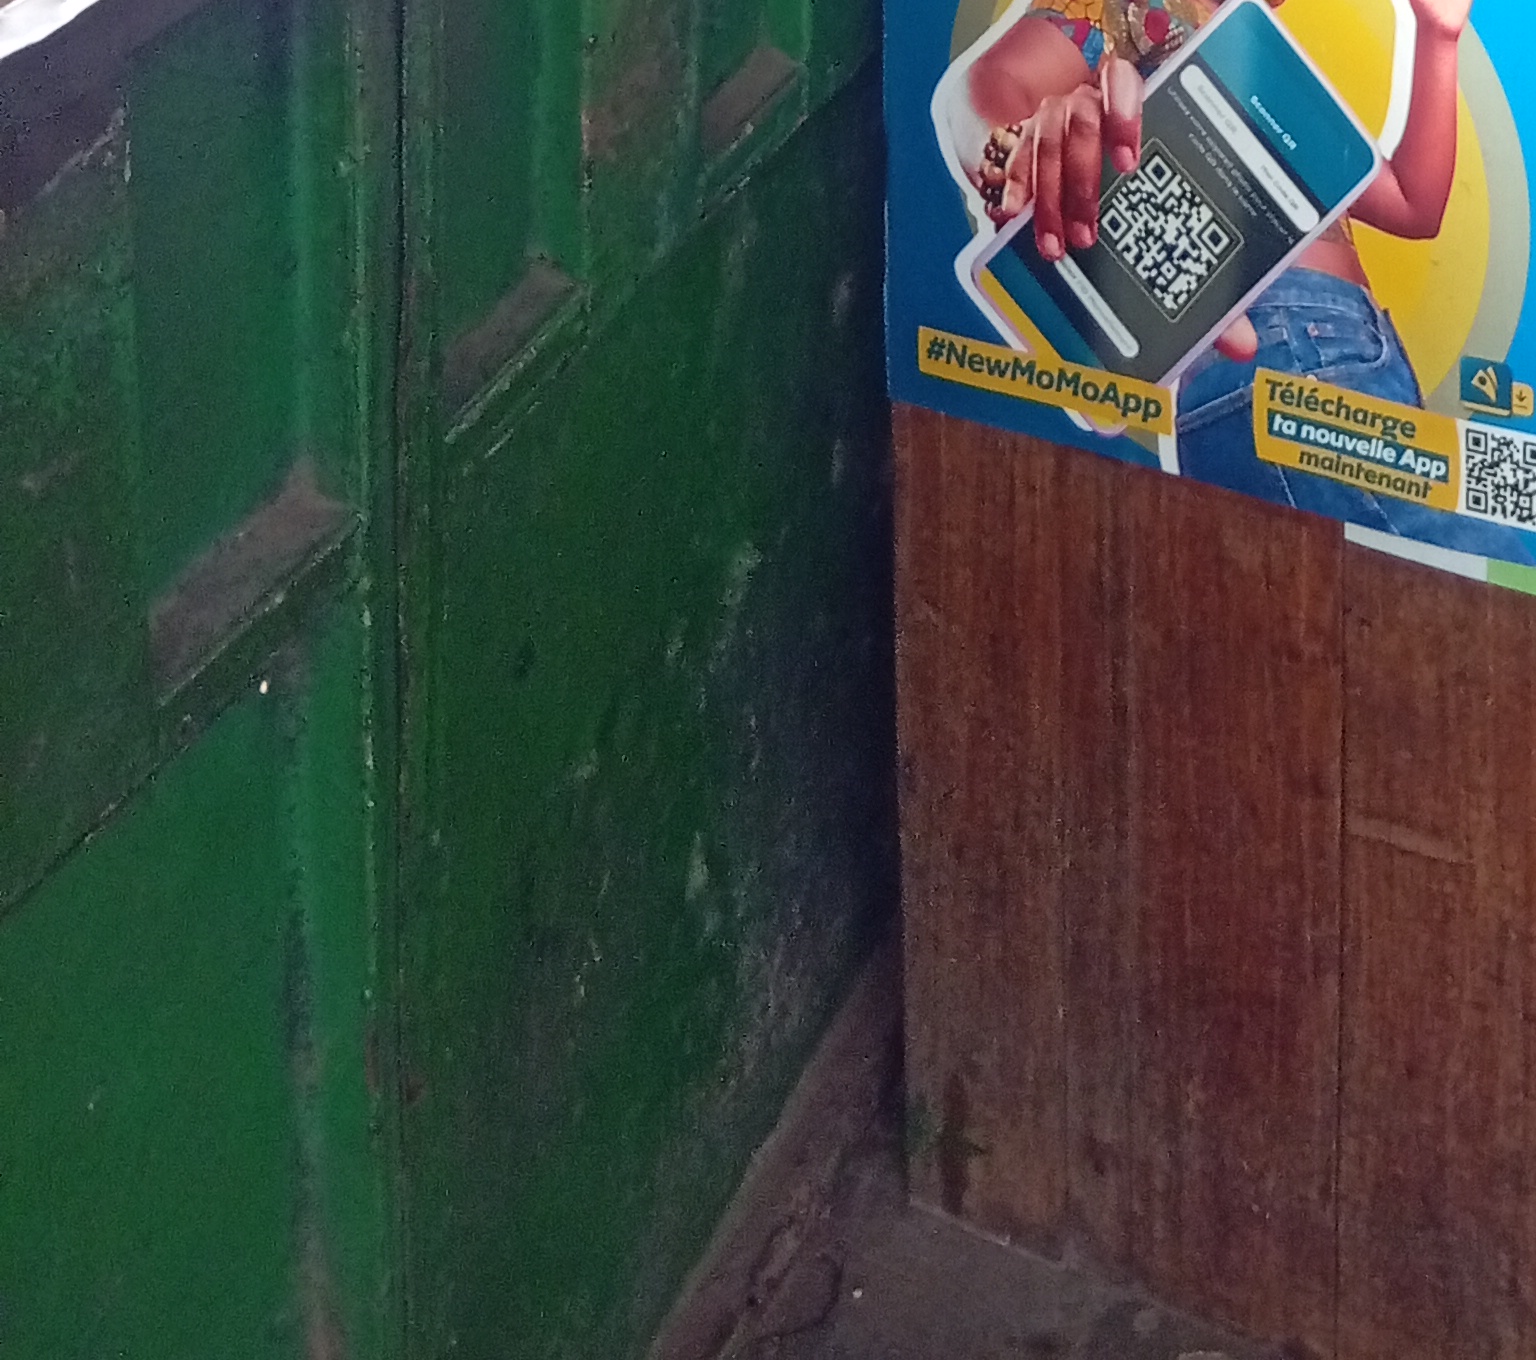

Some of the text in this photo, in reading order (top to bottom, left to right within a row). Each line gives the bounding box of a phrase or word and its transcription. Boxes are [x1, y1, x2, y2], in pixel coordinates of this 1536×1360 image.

[926, 336, 1163, 423] #NewMoMoApp
[1265, 378, 1417, 441] Télécharge
[1273, 413, 1447, 479] ta nouvelle App
[1298, 450, 1433, 499] maintenant
